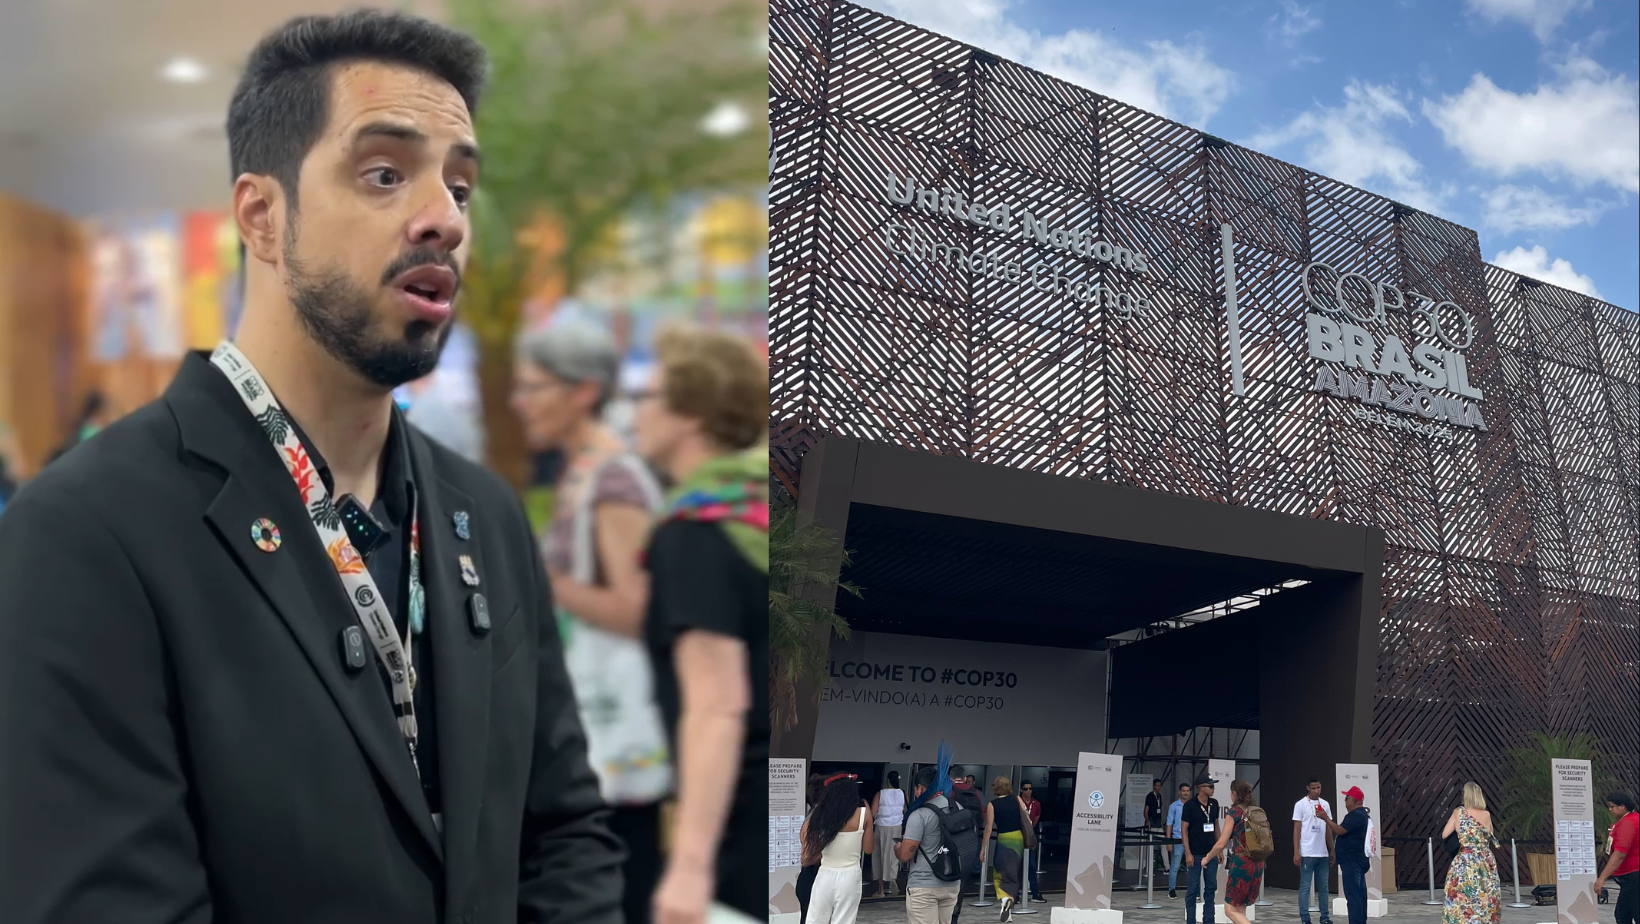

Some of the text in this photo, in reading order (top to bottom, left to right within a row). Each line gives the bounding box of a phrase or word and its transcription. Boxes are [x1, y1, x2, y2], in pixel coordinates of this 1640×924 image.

[887, 172, 1149, 274] United Nations
[885, 223, 1151, 322] Climate Change
[1306, 313, 1484, 401] BRASIL
[1413, 421, 1453, 440] 2025
[820, 687, 1004, 710] EM-VINDO(A) A #COP30
[825, 660, 1018, 688] LCOME TO #COP30
